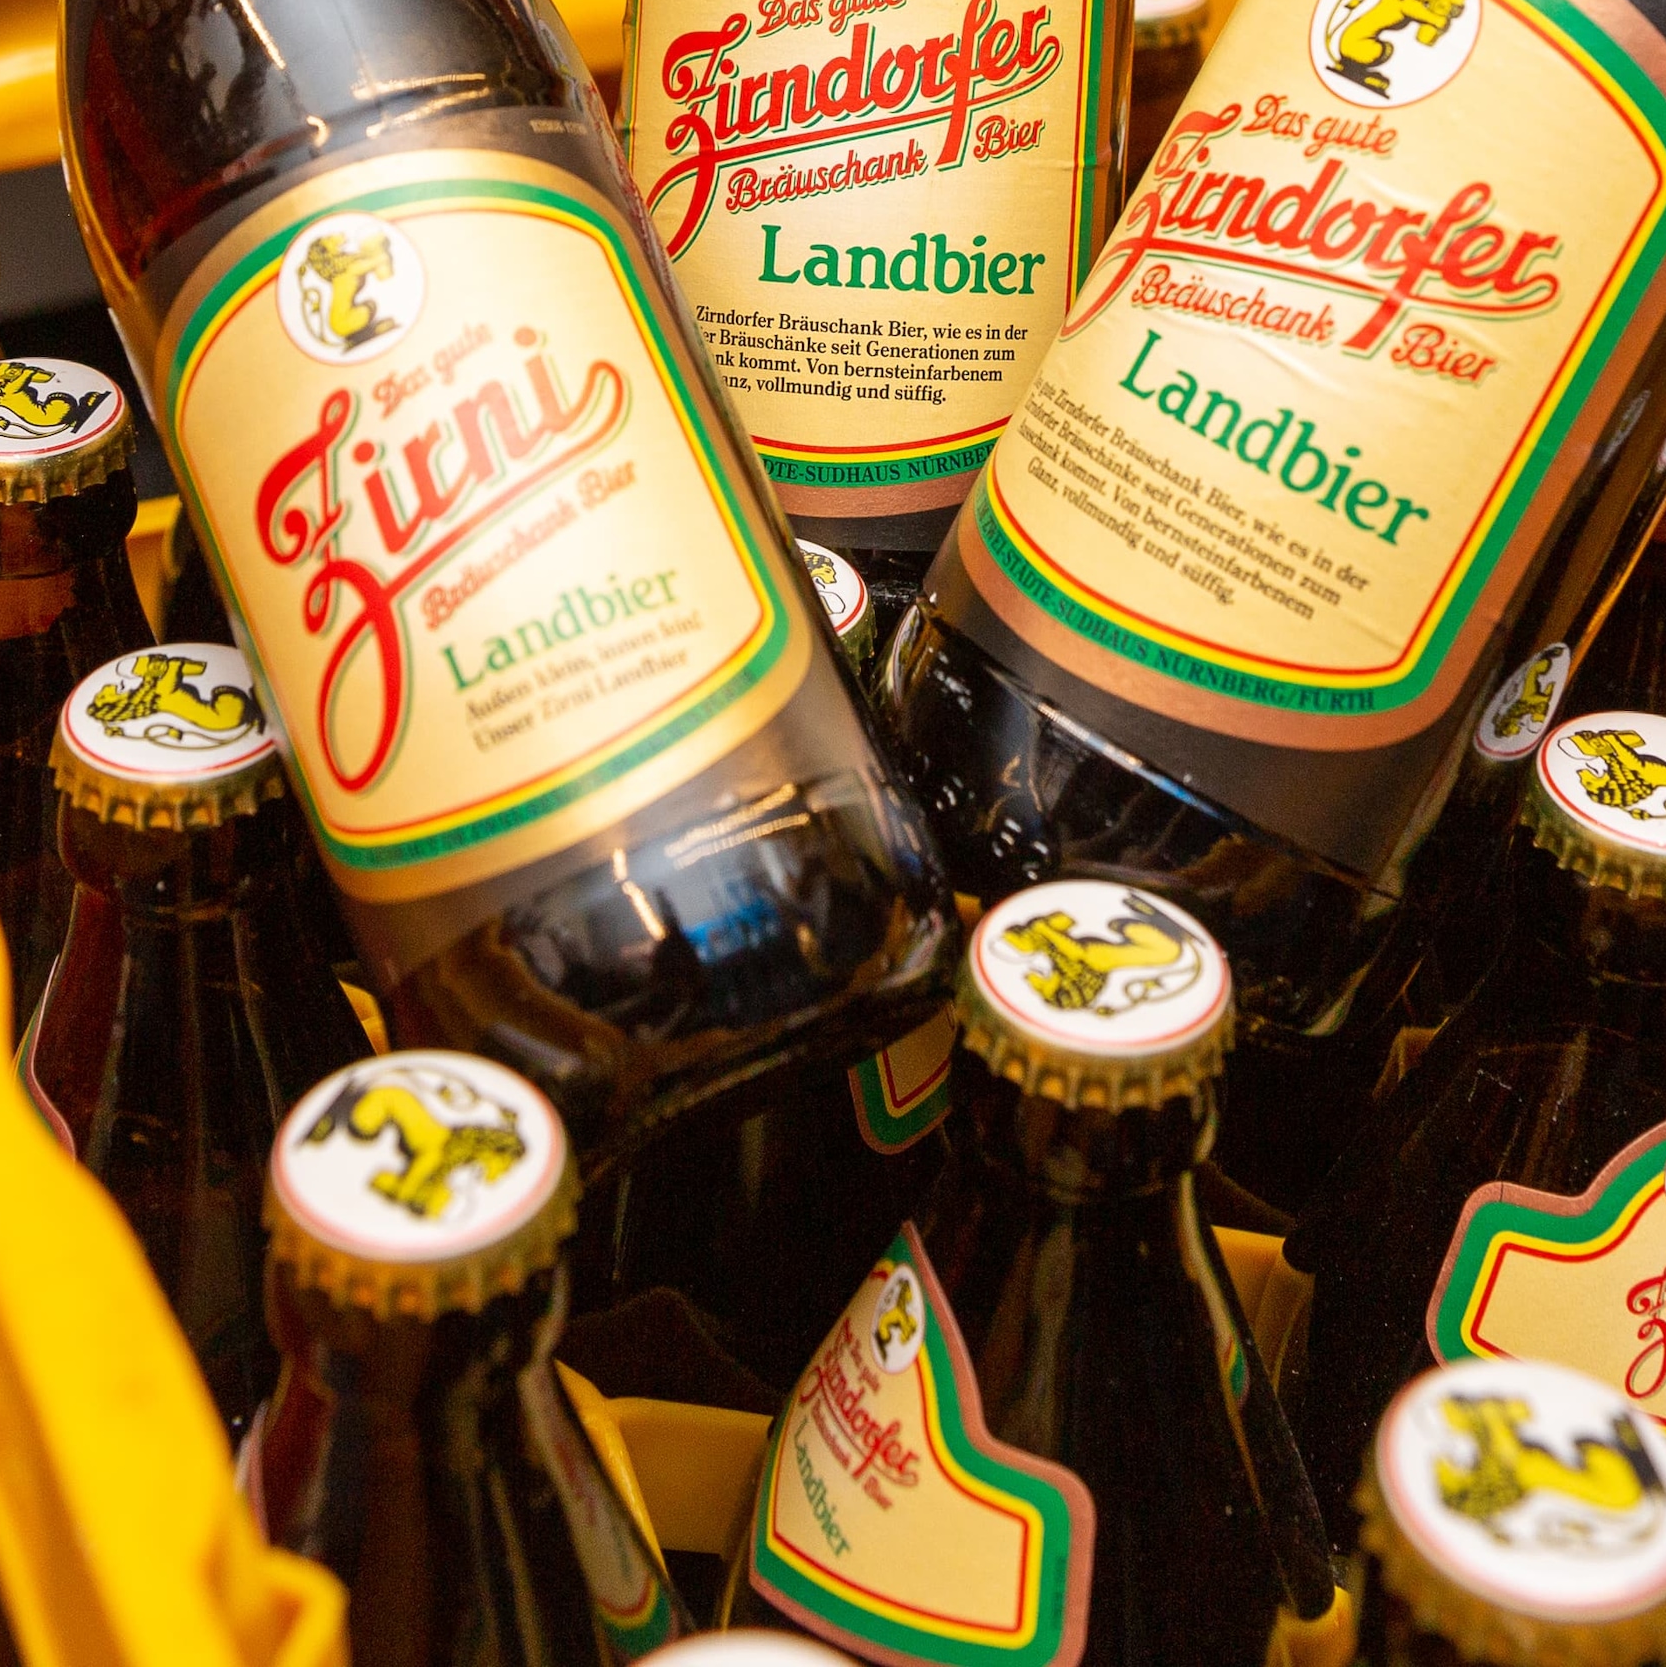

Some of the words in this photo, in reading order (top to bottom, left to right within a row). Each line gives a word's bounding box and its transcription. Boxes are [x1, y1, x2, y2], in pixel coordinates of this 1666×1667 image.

[726, 139, 928, 213] Bräuschank
[973, 115, 1046, 161] Bier
[1241, 92, 1310, 142] Das
[1302, 114, 1399, 160] gute
[758, 224, 1046, 295] Landbier
[1058, 103, 1561, 359] Zirndorfer
[696, 305, 774, 329] Zirndorfer
[778, 313, 883, 336] Bräuschank
[888, 320, 928, 341] Bier,
[933, 323, 961, 339] wie
[966, 327, 982, 340] es
[985, 324, 1001, 340] in
[1004, 324, 1028, 341] der
[720, 329, 827, 354] Bräuschänke
[830, 339, 861, 356] seit
[866, 340, 979, 361] Generationen
[983, 348, 1016, 362] zum
[739, 352, 801, 373] kommt.
[806, 358, 839, 375] Von
[844, 361, 1003, 382] bernsteinfarbenem
[1132, 262, 1338, 344] Bräuschank
[1391, 323, 1499, 386] Bier
[722, 375, 752, 392] anz,
[756, 377, 852, 401] vollmundig
[857, 384, 890, 399] und
[894, 385, 947, 406] süffig.
[1118, 328, 1430, 547] Landbier
[763, 459, 900, 484] DTE-SUDHAUS
[1109, 426, 1204, 498] Bräuschank
[1206, 486, 1245, 527] Bier,
[1253, 518, 1285, 546] wie
[1288, 539, 1309, 560] es
[1313, 548, 1333, 574] in
[1336, 564, 1370, 591] der
[254, 326, 632, 794] Zirni
[1062, 484, 1144, 550] vollmundig
[1142, 537, 1181, 570] und
[1180, 561, 1235, 607] süffig.
[1112, 483, 1142, 518] Von
[1143, 507, 1315, 621] bernsteinfarbenem
[1143, 482, 1175, 507] seit
[1174, 497, 1296, 581] Generationen
[1299, 573, 1341, 606] zum
[439, 566, 681, 694] Landbier
